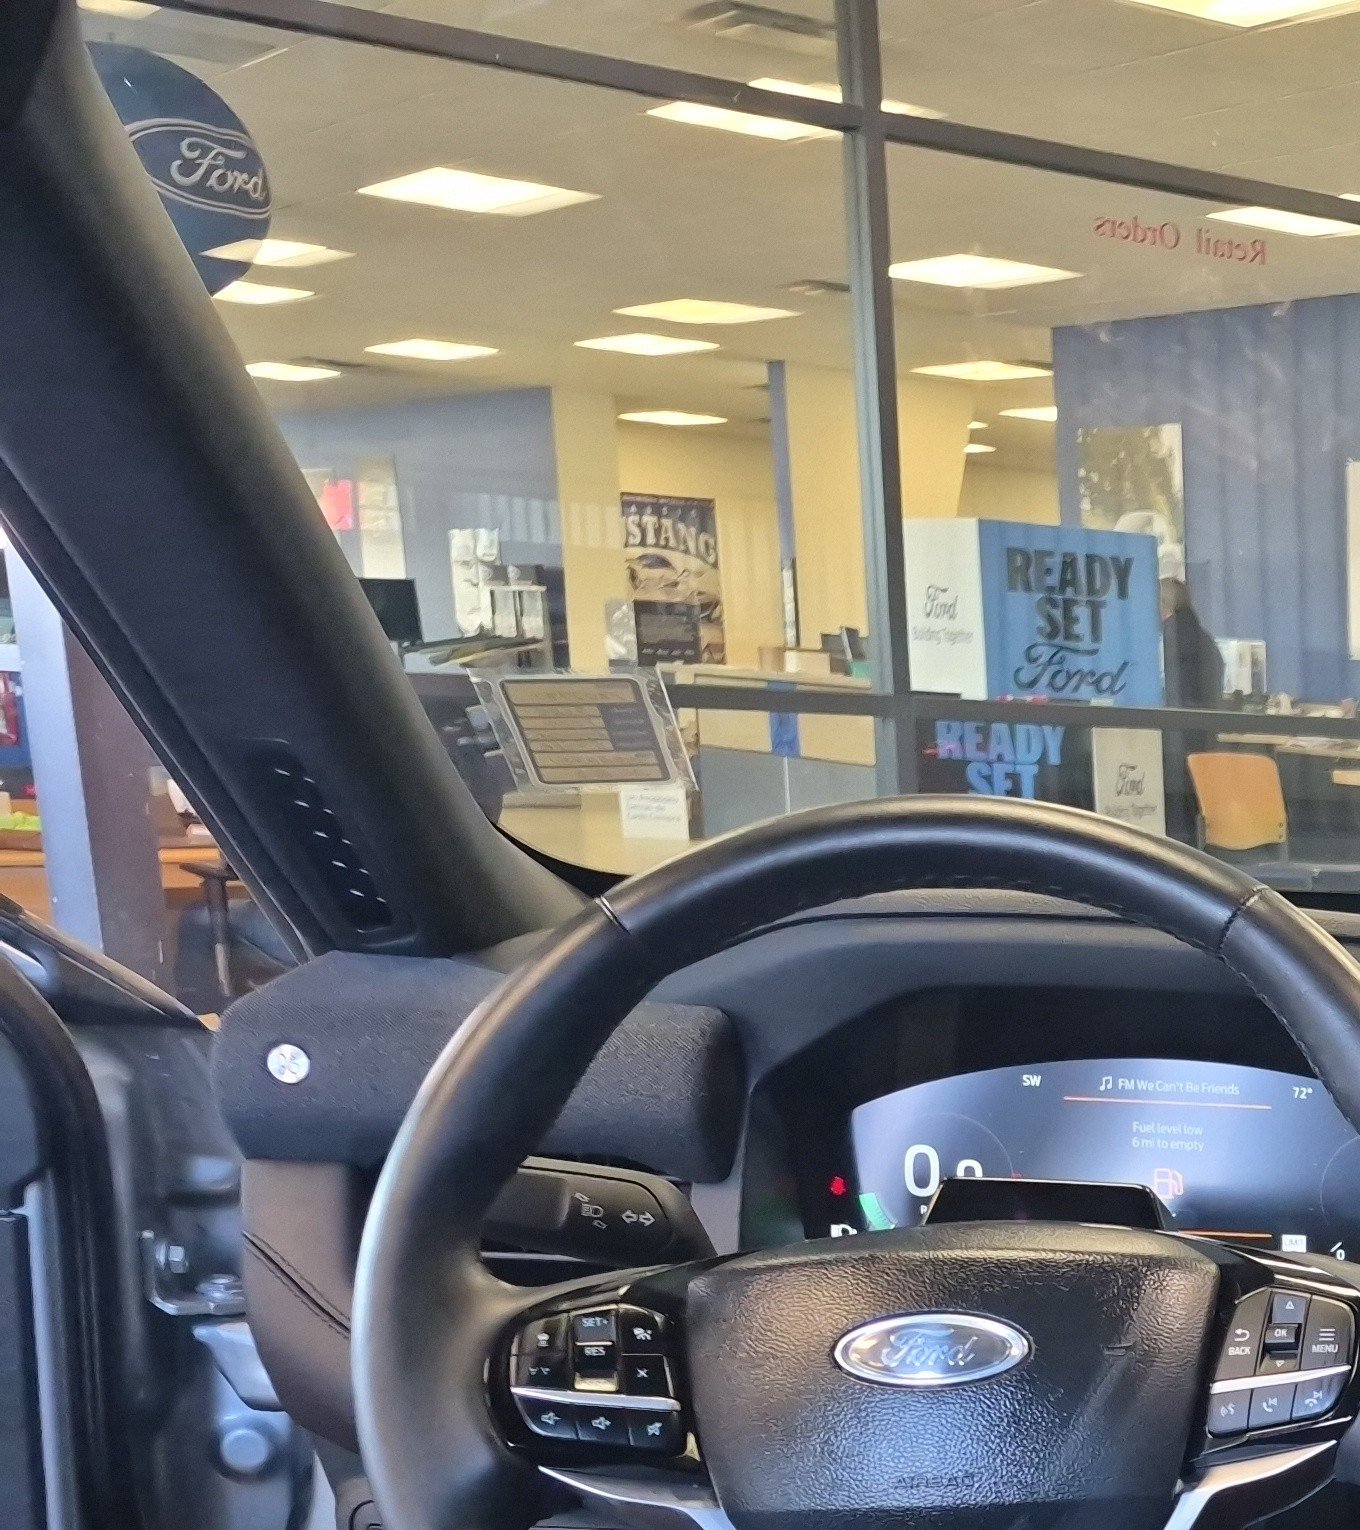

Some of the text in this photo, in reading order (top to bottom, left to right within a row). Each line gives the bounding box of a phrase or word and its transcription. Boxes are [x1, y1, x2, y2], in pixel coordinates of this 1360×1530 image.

[169, 136, 267, 200] Ford
[625, 513, 717, 565] STANG
[1005, 547, 1134, 600] READY
[924, 584, 959, 620] Ford
[1035, 596, 1109, 643] SET
[1012, 642, 1130, 697] Ford
[934, 720, 1066, 766] READY
[965, 762, 1040, 800] SET
[1022, 1074, 1042, 1087] SW
[1117, 1078, 1240, 1096] FM We Can't Be Friends
[1132, 1121, 1203, 1136] Fuel level low
[1132, 1136, 1205, 1153] 6 mi to empty
[903, 1143, 941, 1198] 0
[880, 1328, 979, 1367] Ford
[1228, 1346, 1251, 1356] BACK
[1274, 1328, 1287, 1338] OK
[1311, 1344, 1339, 1354] MENU
